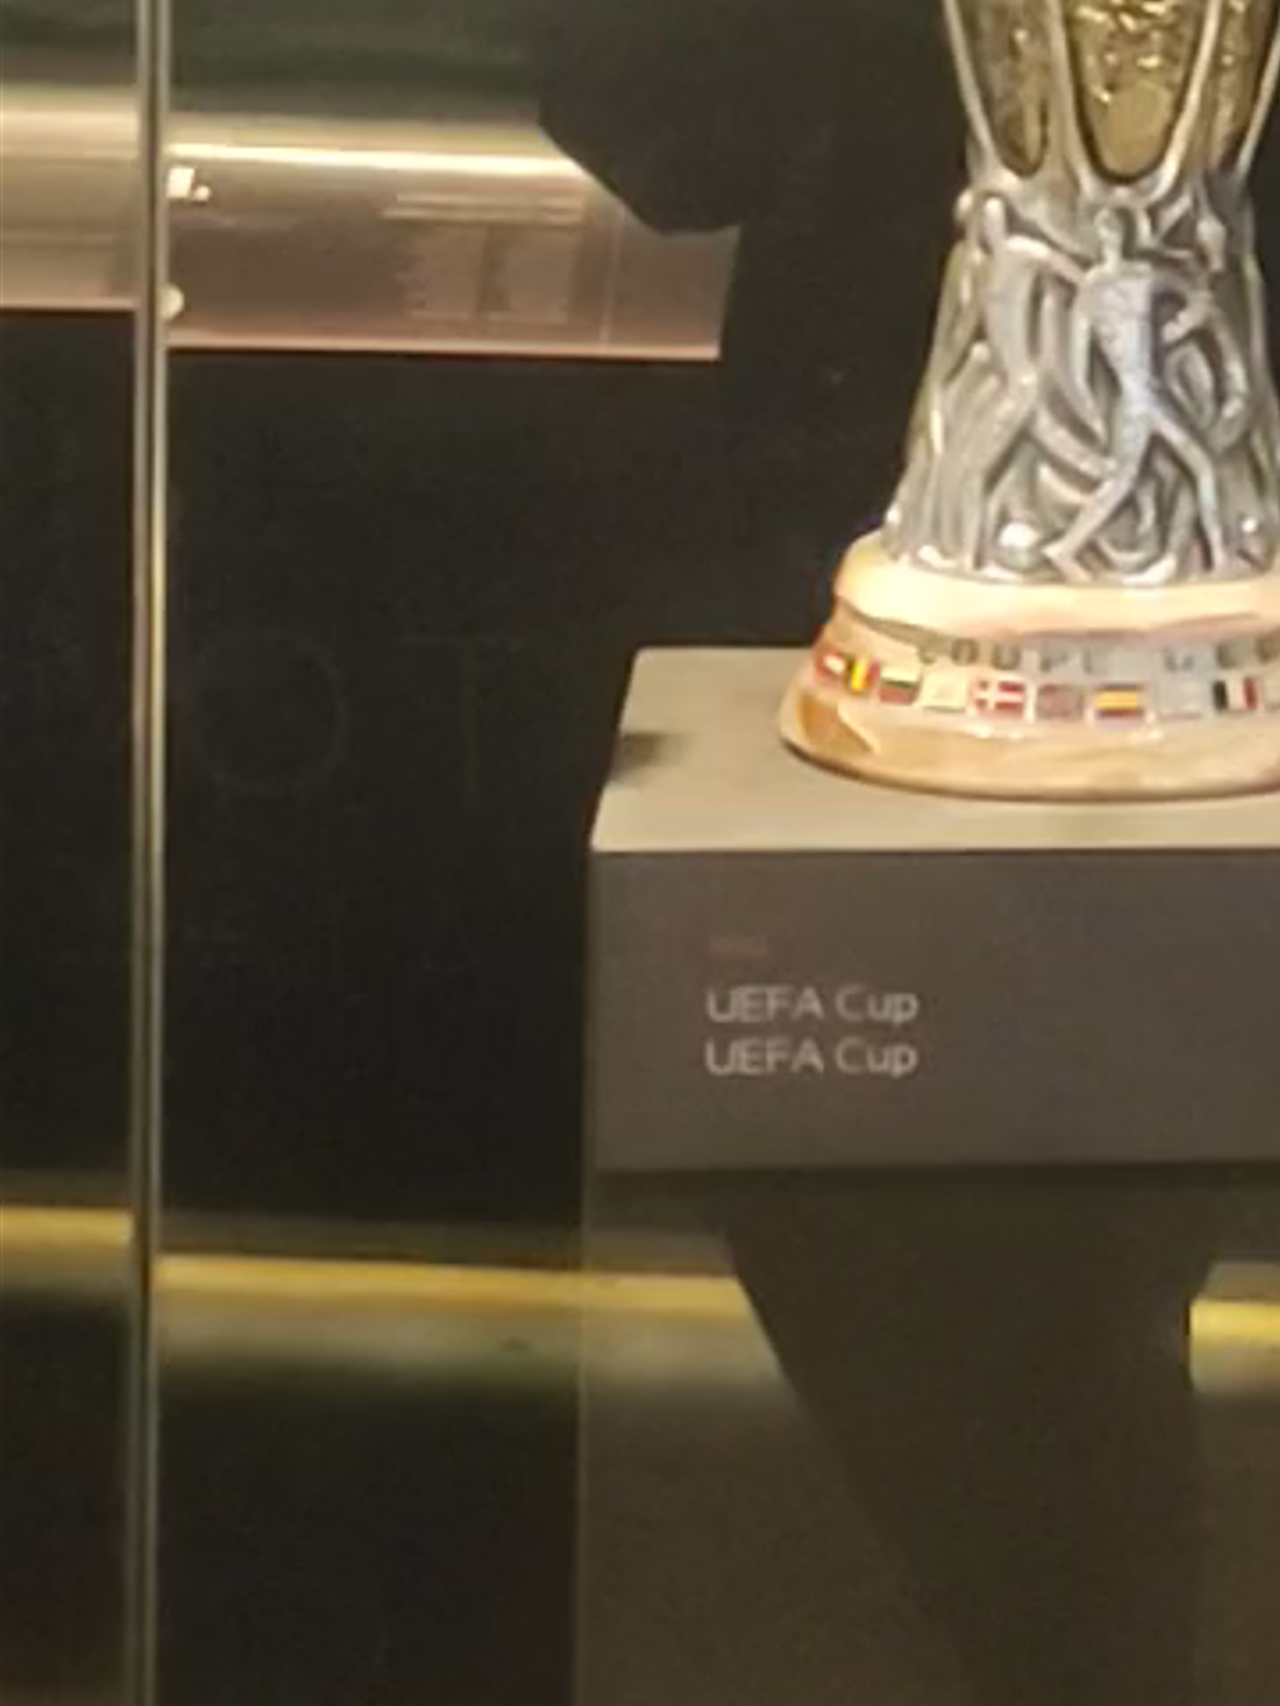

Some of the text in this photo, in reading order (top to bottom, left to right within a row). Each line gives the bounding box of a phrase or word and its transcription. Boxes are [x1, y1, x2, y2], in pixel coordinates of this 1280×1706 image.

[705, 984, 920, 1025] UEFA Cup
[704, 1036, 920, 1077] UEFA Cup
